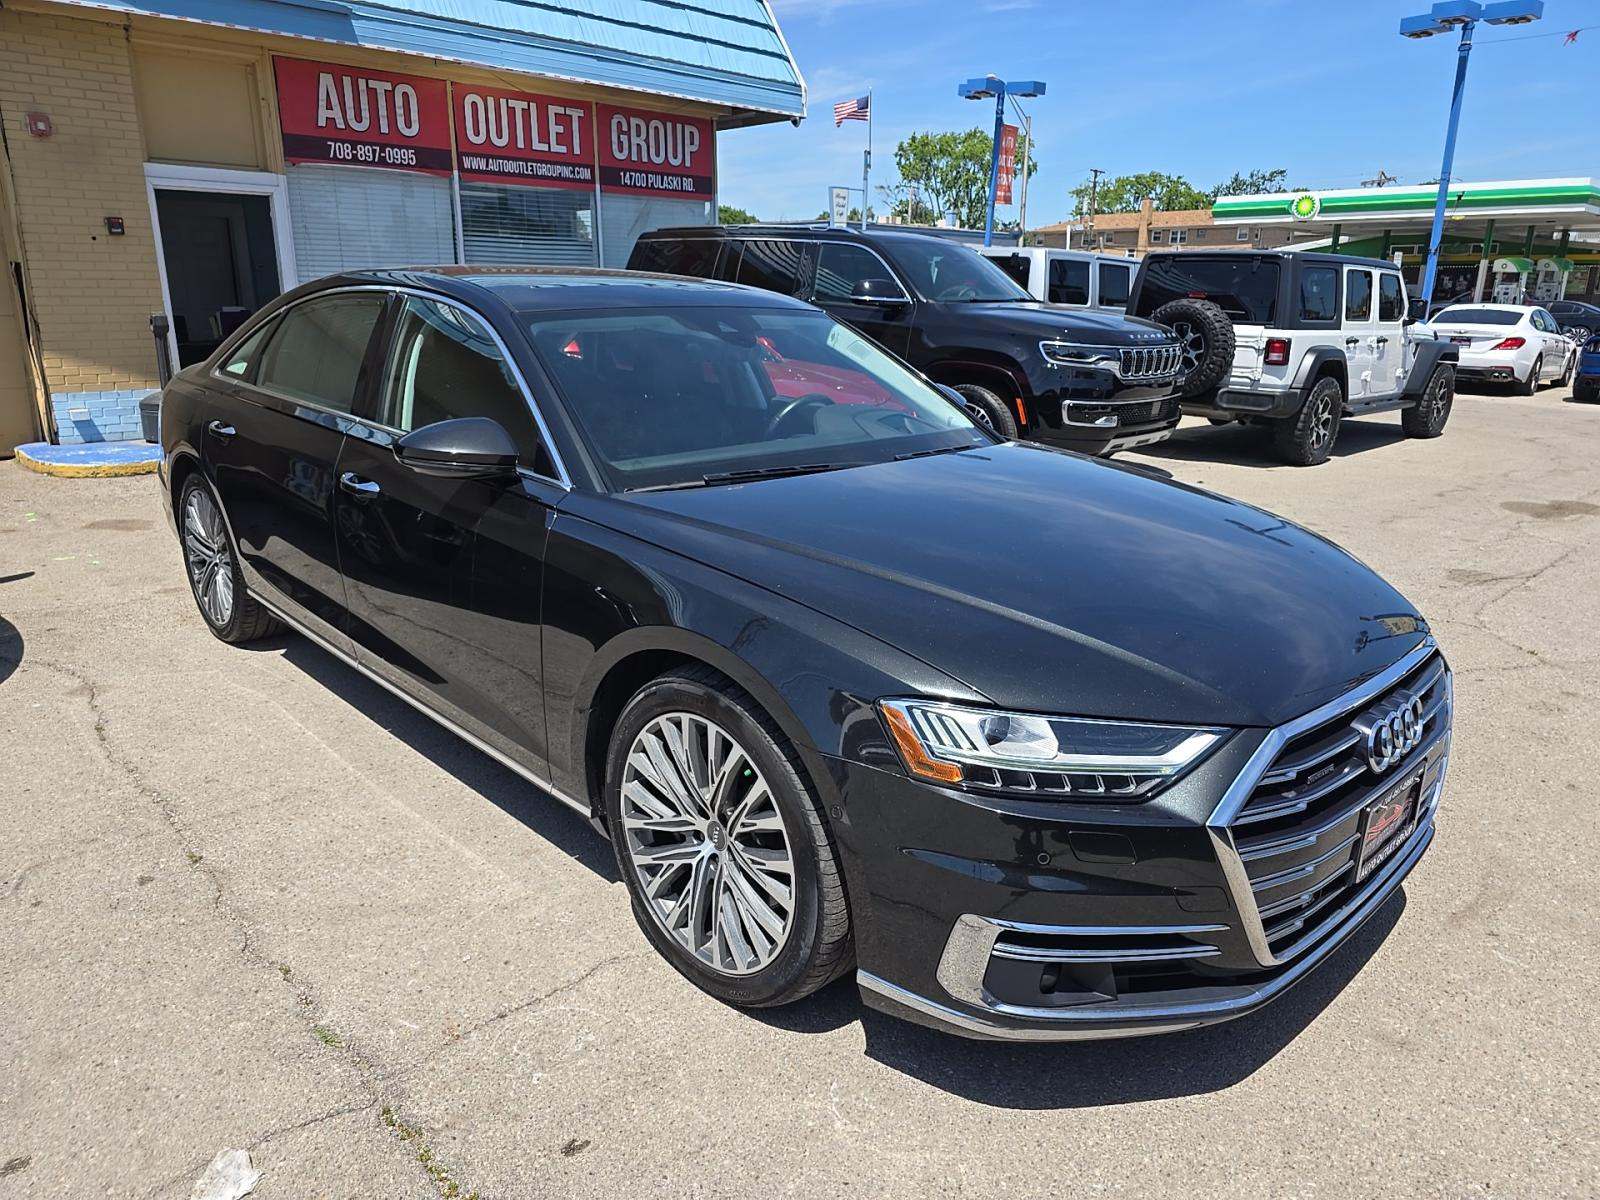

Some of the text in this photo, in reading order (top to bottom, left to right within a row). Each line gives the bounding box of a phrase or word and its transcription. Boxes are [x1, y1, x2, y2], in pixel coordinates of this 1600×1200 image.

[317, 72, 700, 167] AUTO OUTLET GROUP
[327, 141, 416, 165] 708-897-0995
[462, 155, 592, 180] WWW.AUTOOUTLETGROUPINC.COM
[620, 171, 696, 192] 14700 PULASKI RD.
